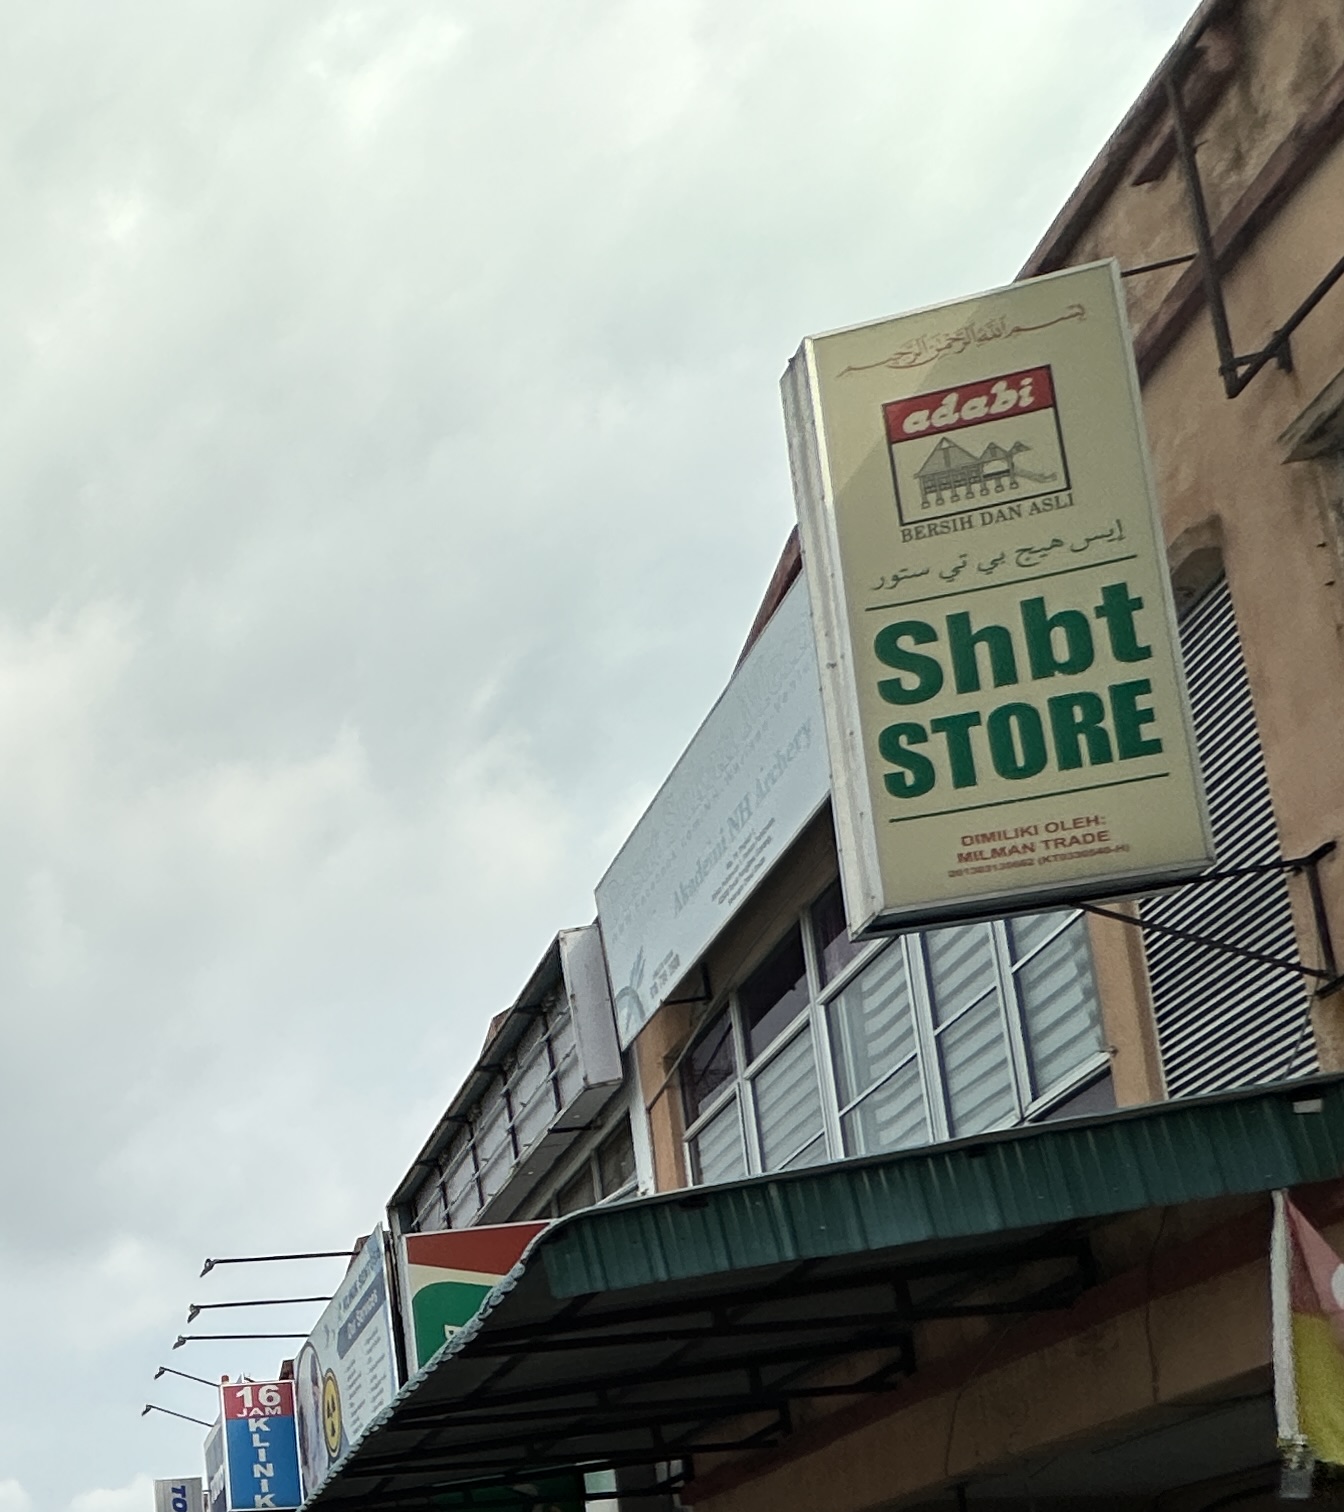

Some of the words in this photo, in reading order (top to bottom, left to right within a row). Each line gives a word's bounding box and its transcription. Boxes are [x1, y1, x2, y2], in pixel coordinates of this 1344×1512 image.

[902, 377, 1035, 434] adabi
[900, 512, 974, 544] BERSIH
[979, 505, 1024, 527] DAN
[1029, 492, 1075, 517] ASLI
[873, 582, 1153, 706] Shbt
[878, 678, 1164, 799] STORE
[956, 841, 1036, 865] MILMAN
[1043, 829, 1111, 851] TRADE
[960, 824, 1039, 847] DIMILIKI
[1044, 814, 1107, 834] OLEH:
[235, 1384, 282, 1408] 16
[236, 1406, 282, 1418] JAM
[248, 1416, 277, 1508] KLINIK
